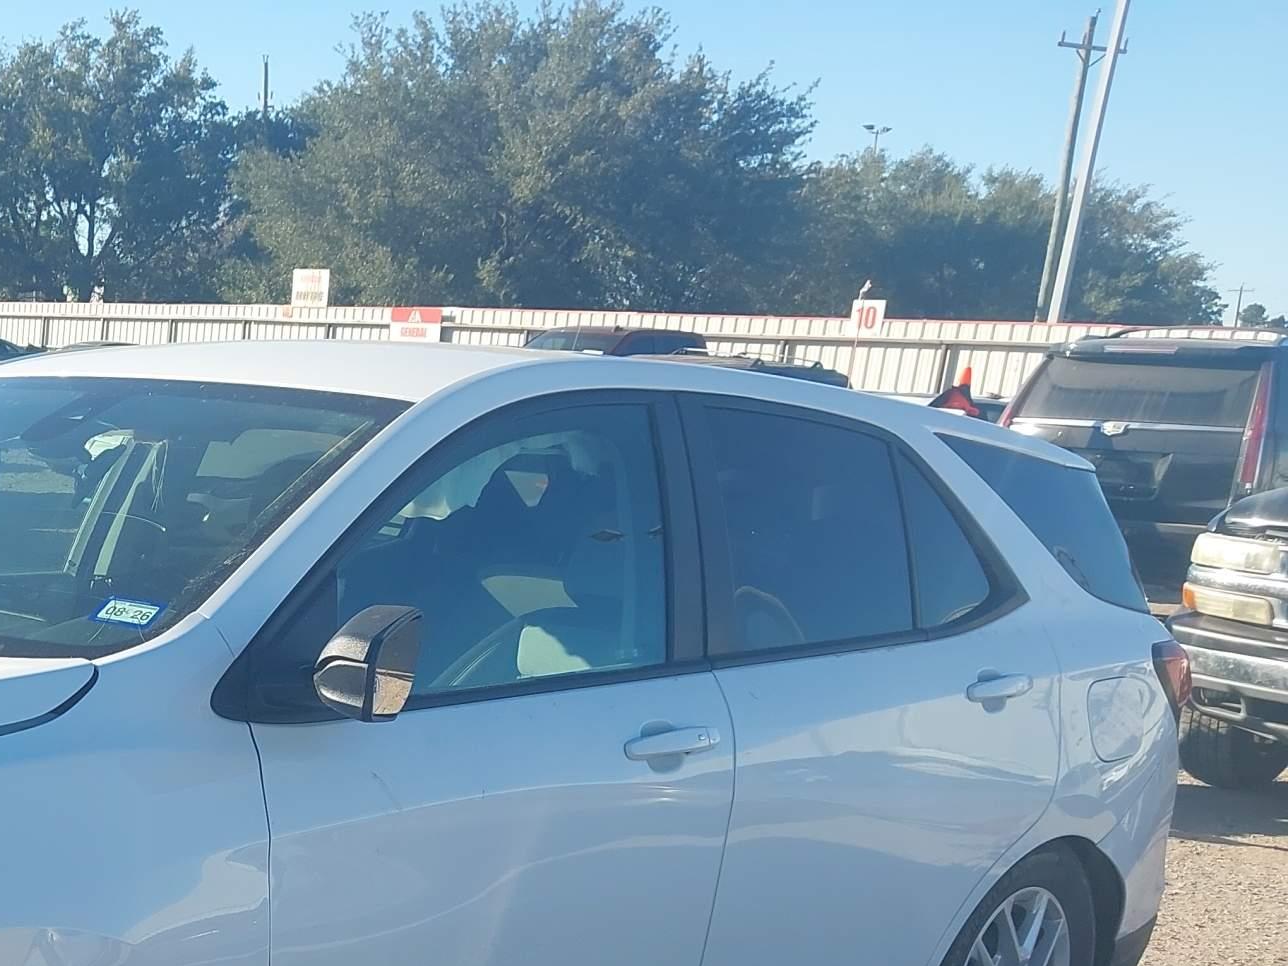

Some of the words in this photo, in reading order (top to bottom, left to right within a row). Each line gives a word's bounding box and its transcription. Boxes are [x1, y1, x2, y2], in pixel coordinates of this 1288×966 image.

[856, 306, 877, 330] 10
[105, 605, 125, 617] 08
[130, 609, 152, 621] 26
